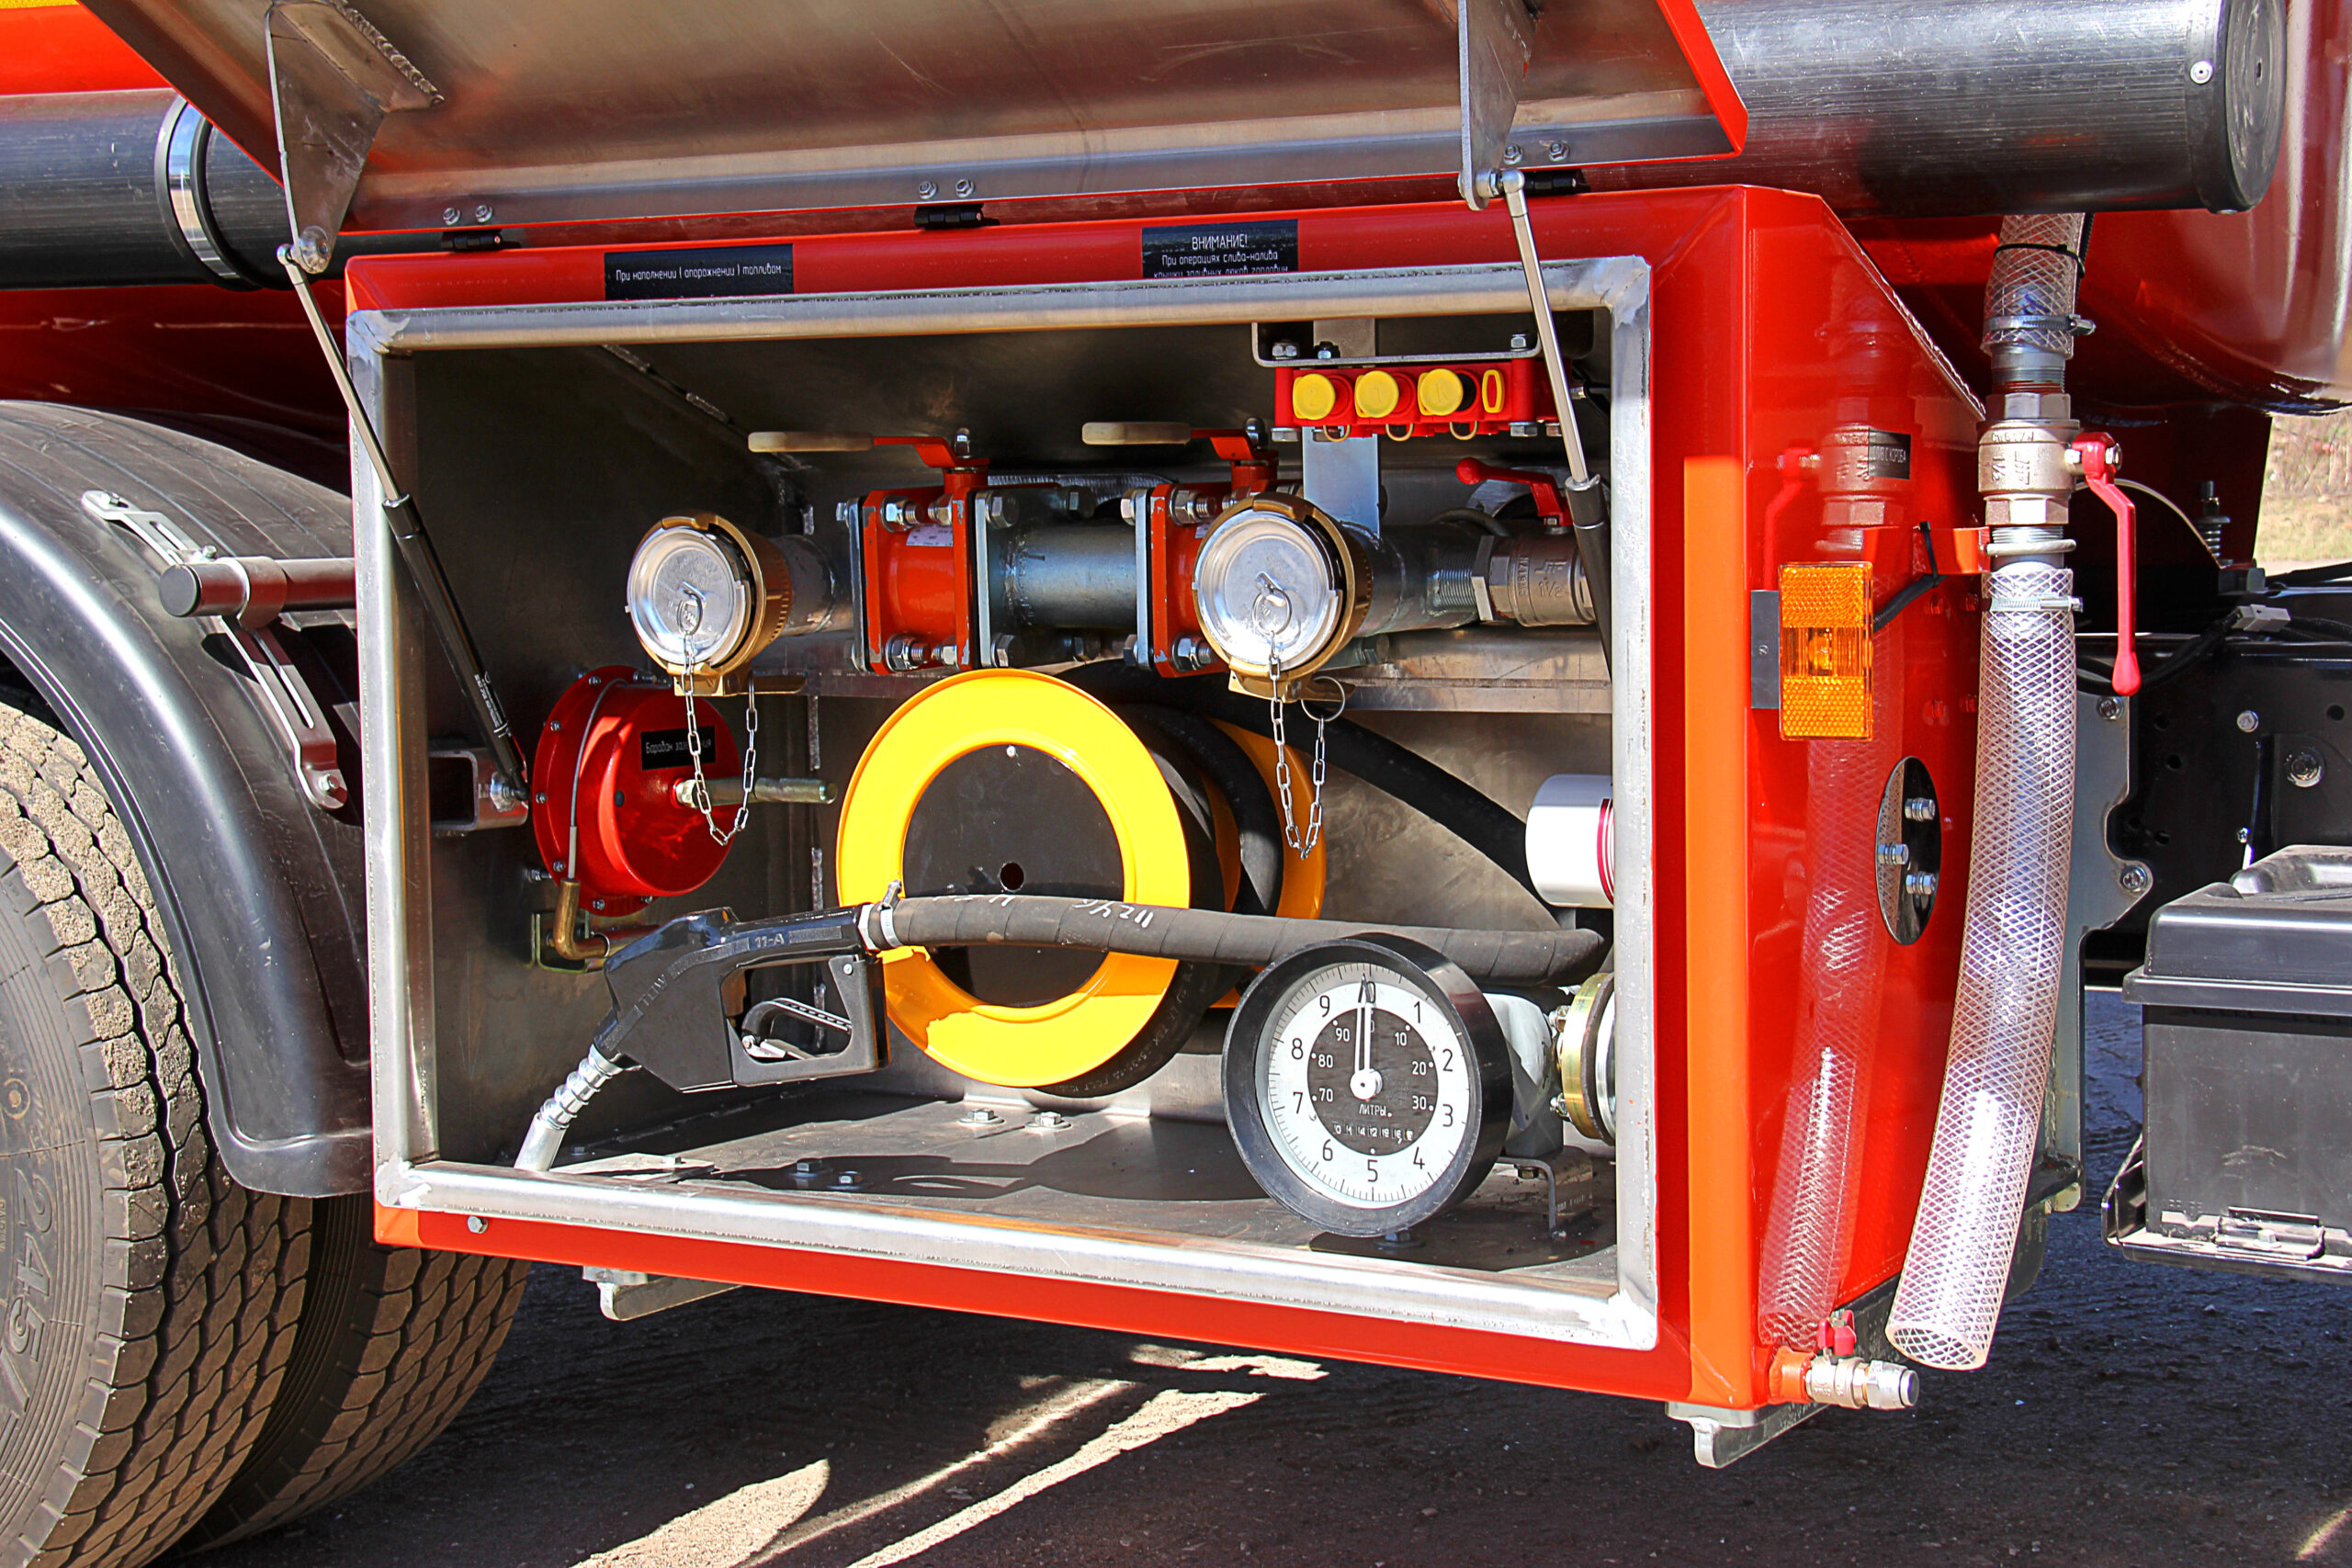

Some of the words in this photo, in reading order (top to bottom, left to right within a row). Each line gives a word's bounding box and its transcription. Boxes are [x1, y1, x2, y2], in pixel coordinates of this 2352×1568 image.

[1192, 233, 1248, 250] ВНИМАНИЕ!
[1161, 254, 1177, 266] При
[1179, 253, 1220, 265] операциях
[616, 269, 630, 282] При
[632, 269, 676, 280] наполнении
[684, 266, 735, 279] опорожнении
[742, 263, 781, 275] топливом
[1319, 995, 1330, 1018] 9
[1413, 1000, 1421, 1024] 1
[1335, 1028, 1351, 1043] 90
[1395, 1032, 1408, 1046] 10
[1292, 1037, 1304, 1060] 8
[1317, 1054, 1334, 1068] 80
[1411, 1061, 1427, 1076] 20
[1442, 1048, 1453, 1072] 2
[1293, 1091, 1304, 1114] 7
[1318, 1088, 1334, 1102] 70
[1411, 1096, 1427, 1111] 30
[1442, 1103, 1453, 1127] 3
[1322, 1139, 1333, 1161] 6
[1413, 1145, 1425, 1169] 4
[1367, 1159, 1379, 1182] 5
